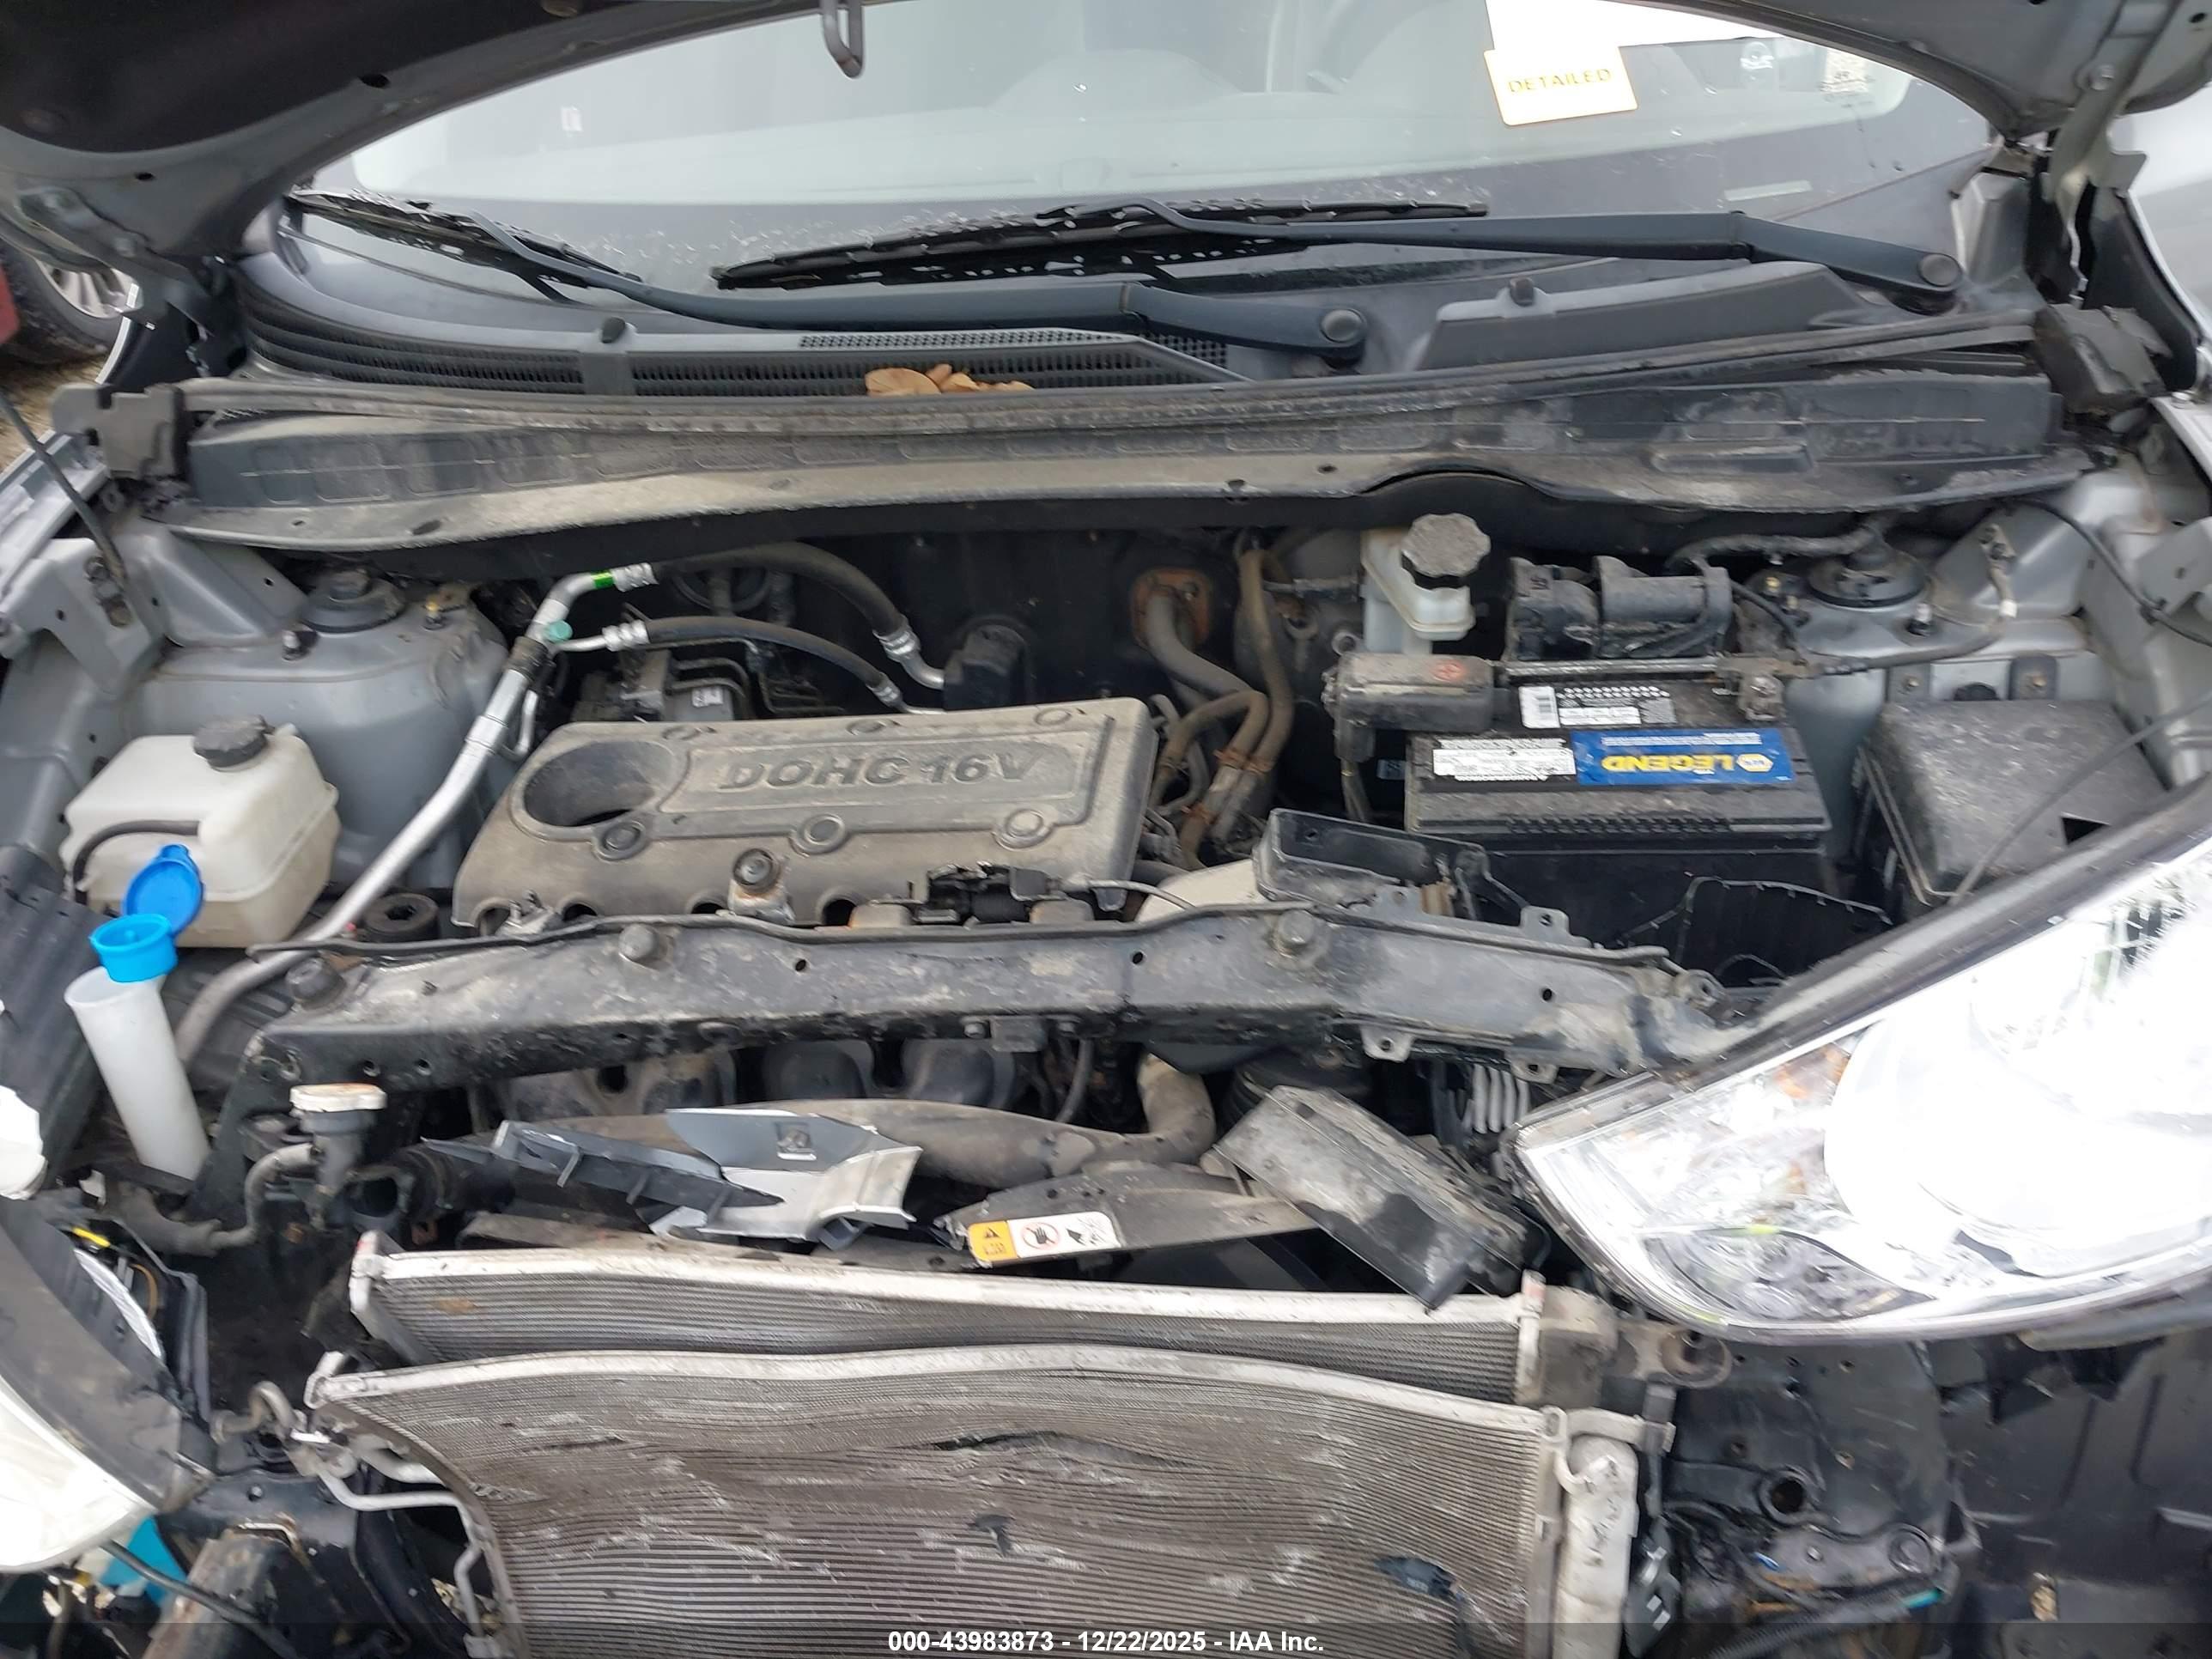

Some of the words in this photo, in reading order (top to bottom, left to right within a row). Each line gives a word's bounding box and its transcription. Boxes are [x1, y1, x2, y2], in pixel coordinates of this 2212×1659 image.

[1508, 68, 1611, 94] DETAILED
[718, 755, 911, 792] DOHC
[919, 751, 1043, 786] 16V
[1601, 754, 1735, 772] LEGEND
